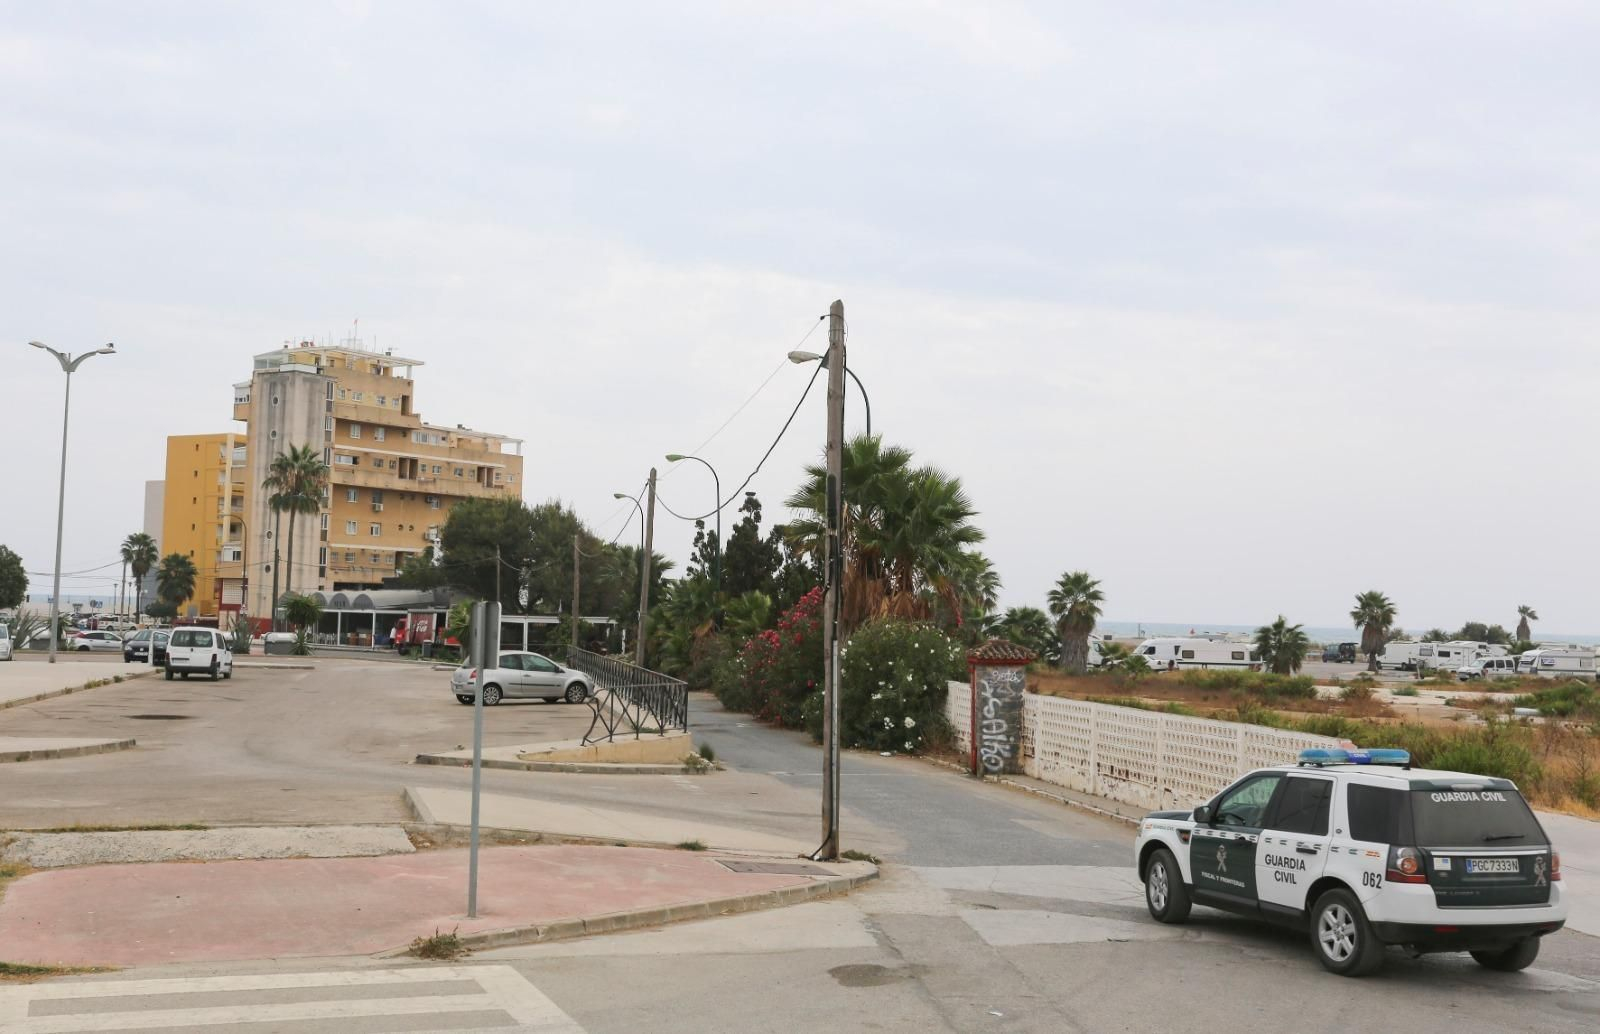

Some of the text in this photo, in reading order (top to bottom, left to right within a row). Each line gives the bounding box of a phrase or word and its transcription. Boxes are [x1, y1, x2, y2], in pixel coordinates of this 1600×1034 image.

[1431, 791, 1506, 803] GUARDIA CIVIL
[1265, 854, 1306, 871] GUARDIA
[1472, 859, 1519, 872] PGC7333N
[1274, 870, 1297, 885] CIVIL
[1362, 871, 1383, 889] 062
